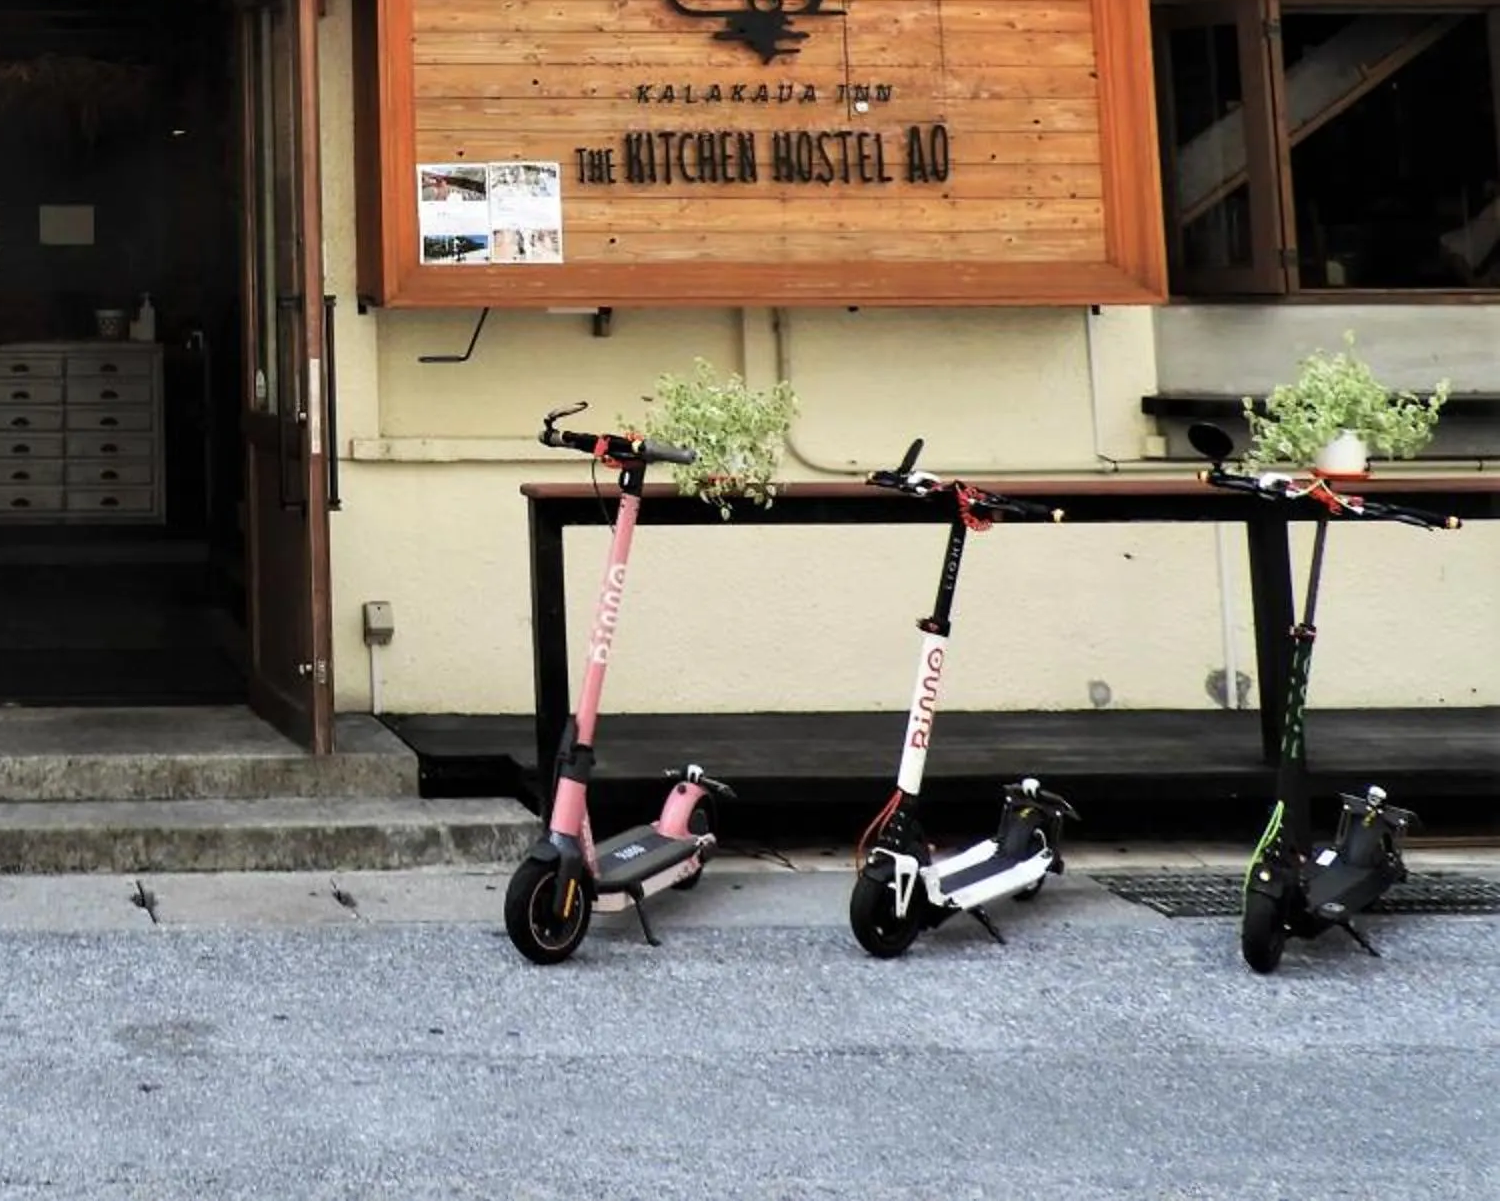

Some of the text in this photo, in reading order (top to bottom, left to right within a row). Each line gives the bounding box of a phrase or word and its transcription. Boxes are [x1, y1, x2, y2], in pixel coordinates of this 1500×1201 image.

[836, 83, 894, 104] INN
[574, 123, 950, 186] THE KITCHEN HOSTEL AO
